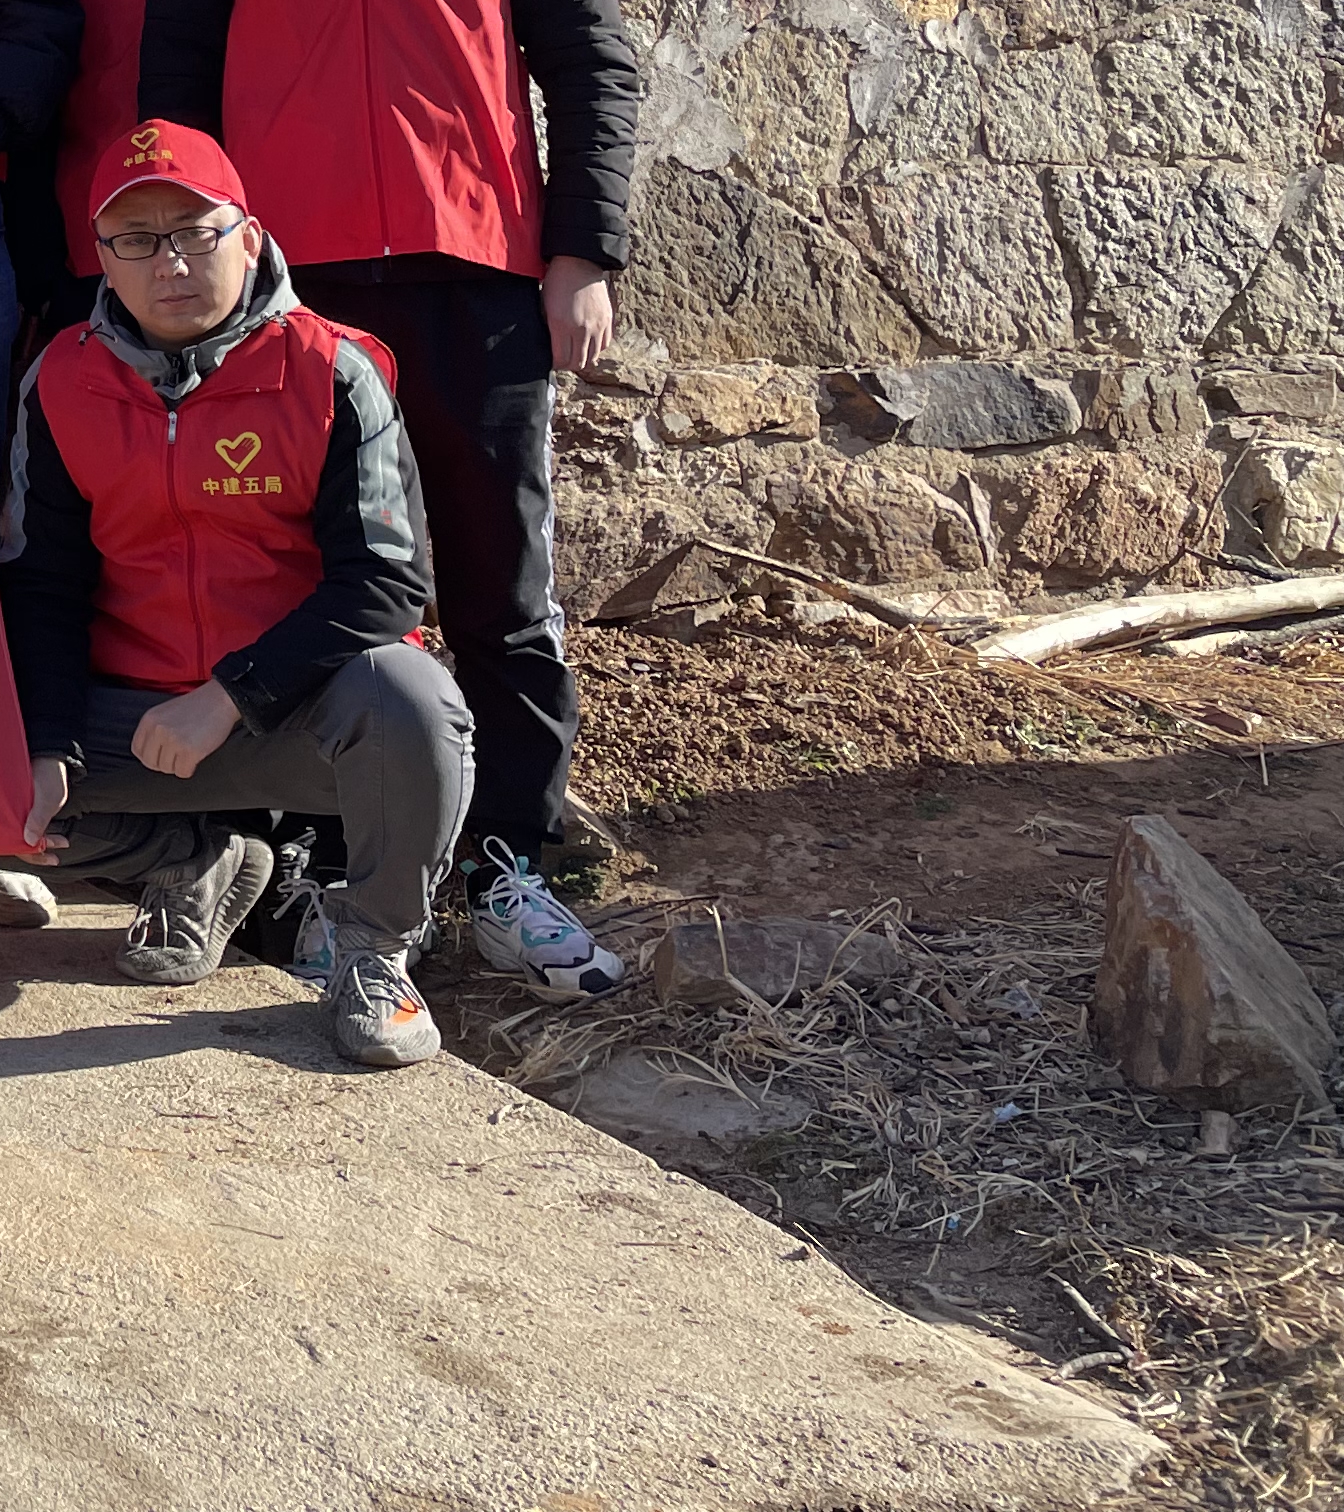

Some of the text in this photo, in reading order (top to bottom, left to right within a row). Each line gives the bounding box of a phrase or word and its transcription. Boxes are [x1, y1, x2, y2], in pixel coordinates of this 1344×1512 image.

[123, 149, 173, 168] 中建五局
[202, 476, 283, 496] 中建五局
